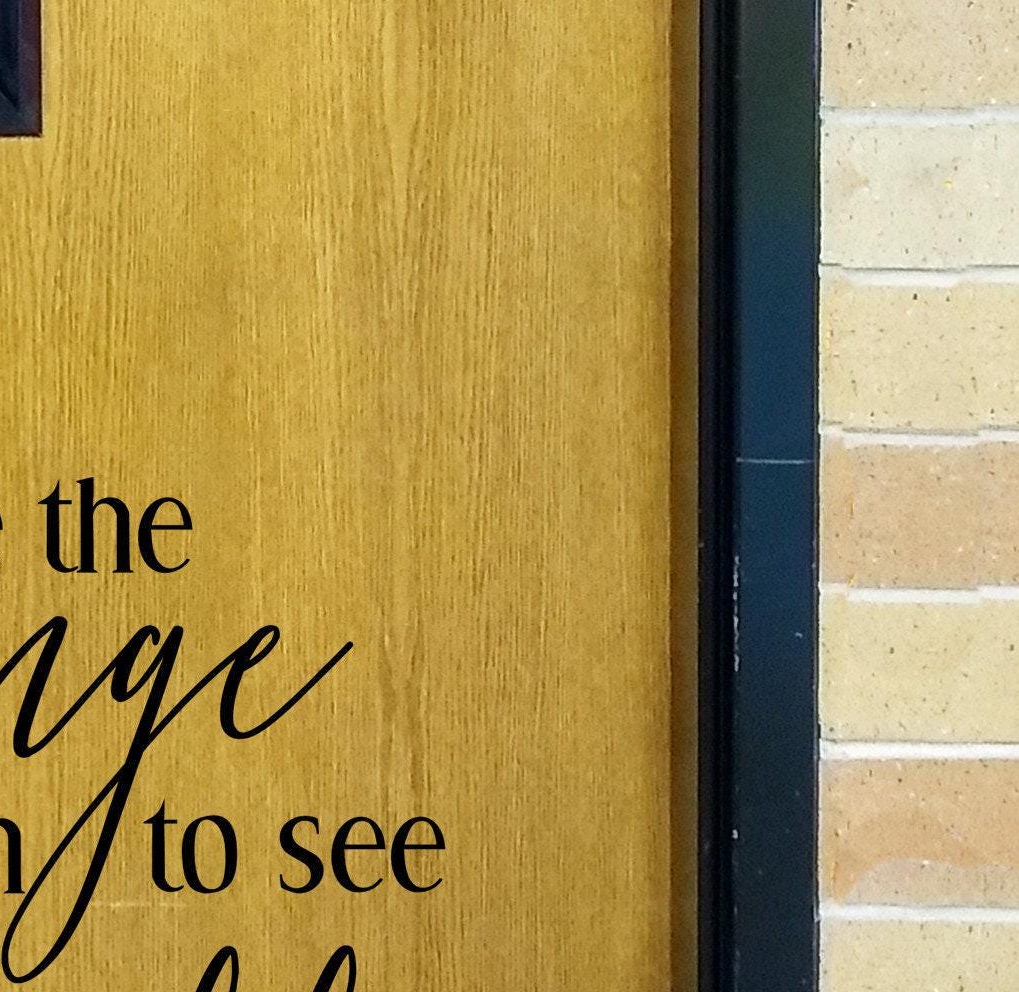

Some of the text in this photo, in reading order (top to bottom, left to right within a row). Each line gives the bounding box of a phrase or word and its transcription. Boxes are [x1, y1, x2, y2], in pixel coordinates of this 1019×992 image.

[37, 476, 193, 574] the
[143, 800, 238, 894] to
[279, 815, 446, 894] see
